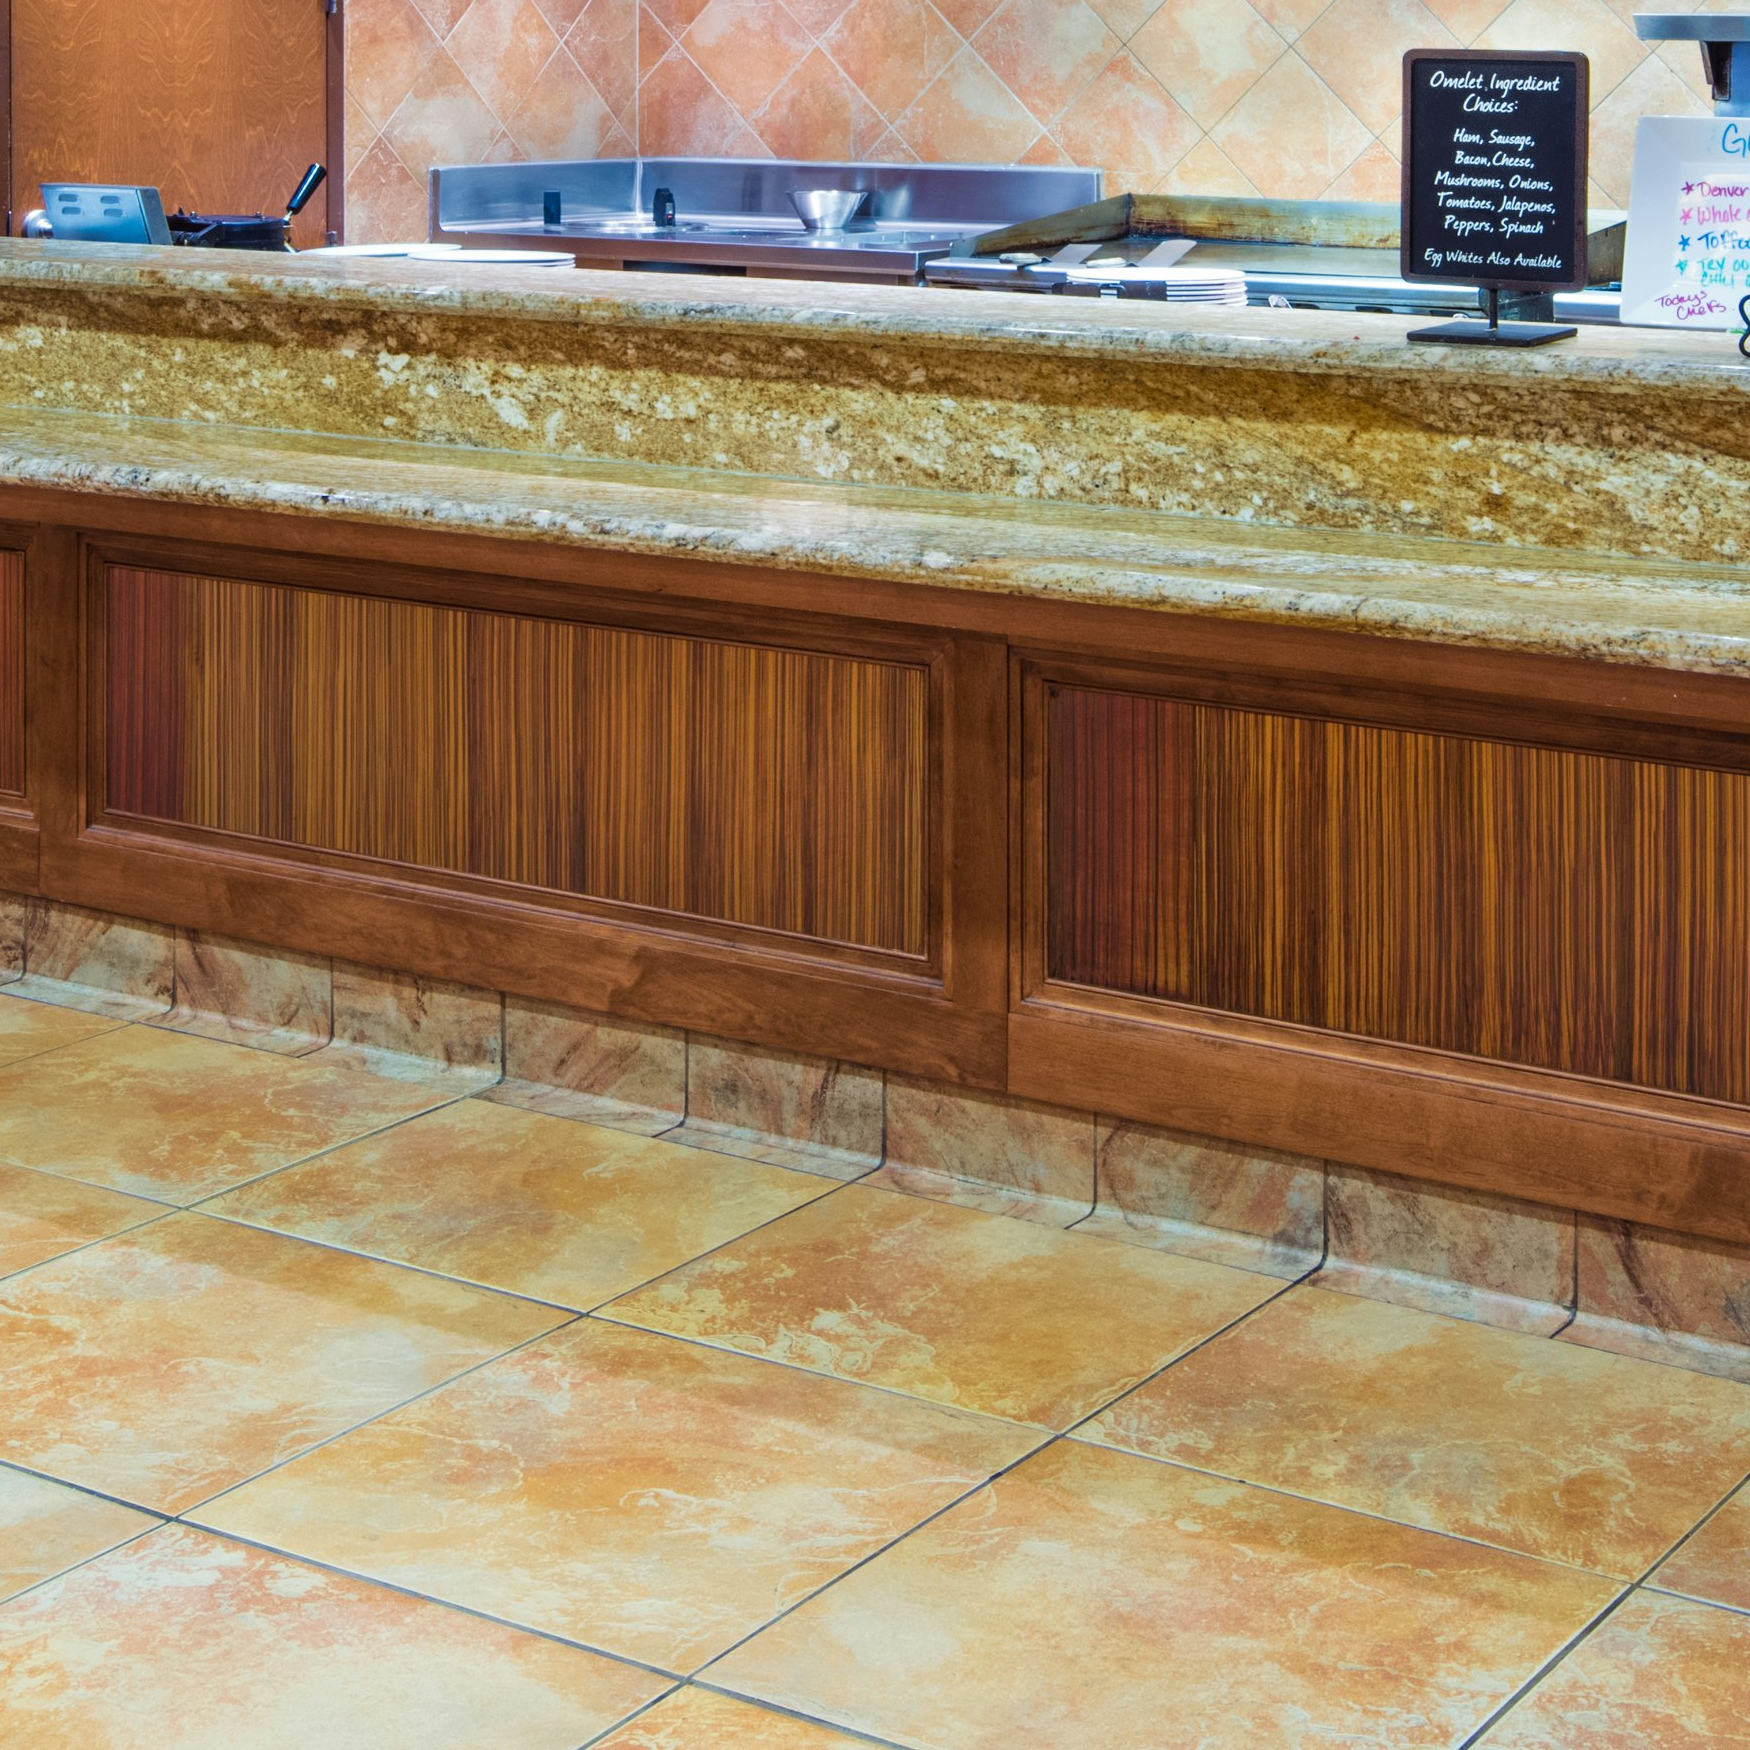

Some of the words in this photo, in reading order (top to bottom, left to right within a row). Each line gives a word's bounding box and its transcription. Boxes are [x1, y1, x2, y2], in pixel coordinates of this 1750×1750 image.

[1429, 70, 1484, 89] Omelet
[1489, 72, 1560, 99] Ingredient
[1462, 92, 1519, 113] Choices:
[1453, 127, 1484, 145] Ham,
[1488, 128, 1535, 149] Sausage,
[1454, 150, 1491, 167] Bacon,
[1491, 151, 1535, 169] Cheese,
[1434, 170, 1505, 190] Mushrooms,
[1508, 174, 1554, 192] Onions,
[1697, 181, 1749, 198] Denver
[1436, 191, 1495, 211] Tomatoes,
[1497, 195, 1556, 218] Jalapenos,
[1697, 204, 1742, 225] Whole
[1444, 214, 1494, 237] Peppers,
[1498, 217, 1544, 239] Spinach
[1424, 247, 1443, 267] Egg
[1446, 249, 1484, 264] Whites
[1486, 251, 1511, 266] Also
[1513, 252, 1562, 269] Available
[1698, 258, 1725, 271] TRY
